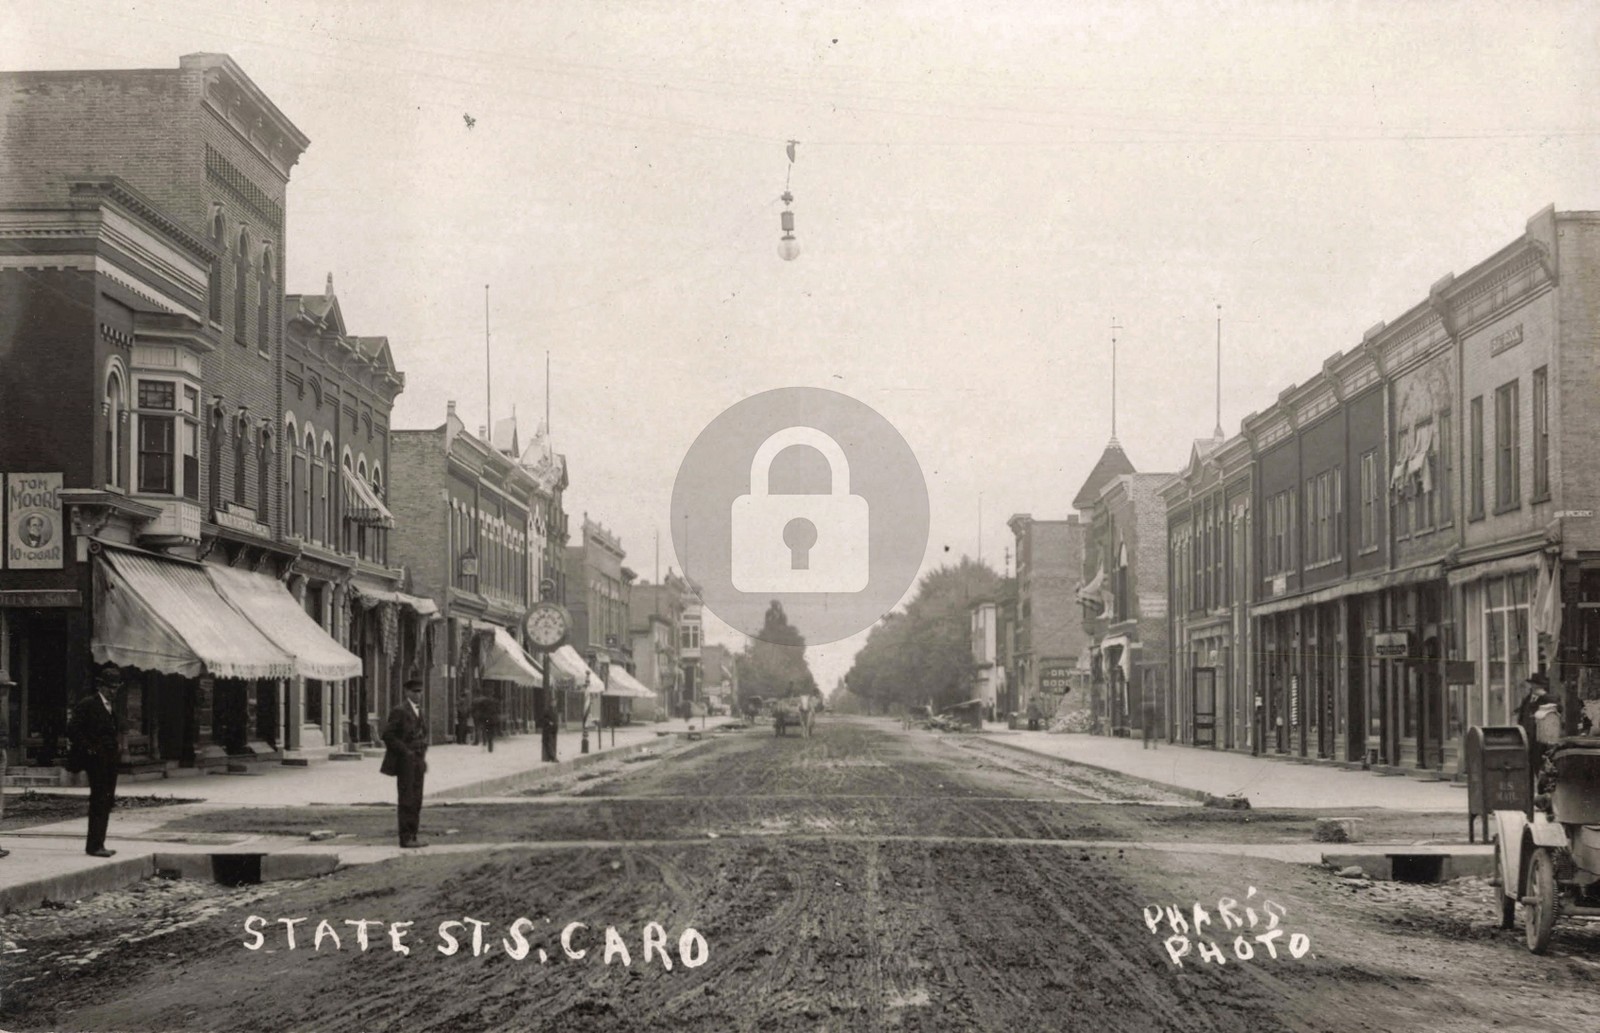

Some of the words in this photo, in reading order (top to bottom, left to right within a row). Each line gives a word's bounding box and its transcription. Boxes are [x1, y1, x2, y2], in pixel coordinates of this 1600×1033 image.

[18, 479, 47, 491] TOM
[10, 484, 61, 513] MOORE
[27, 545, 61, 561] CIGAR
[1051, 669, 1071, 677] DRY
